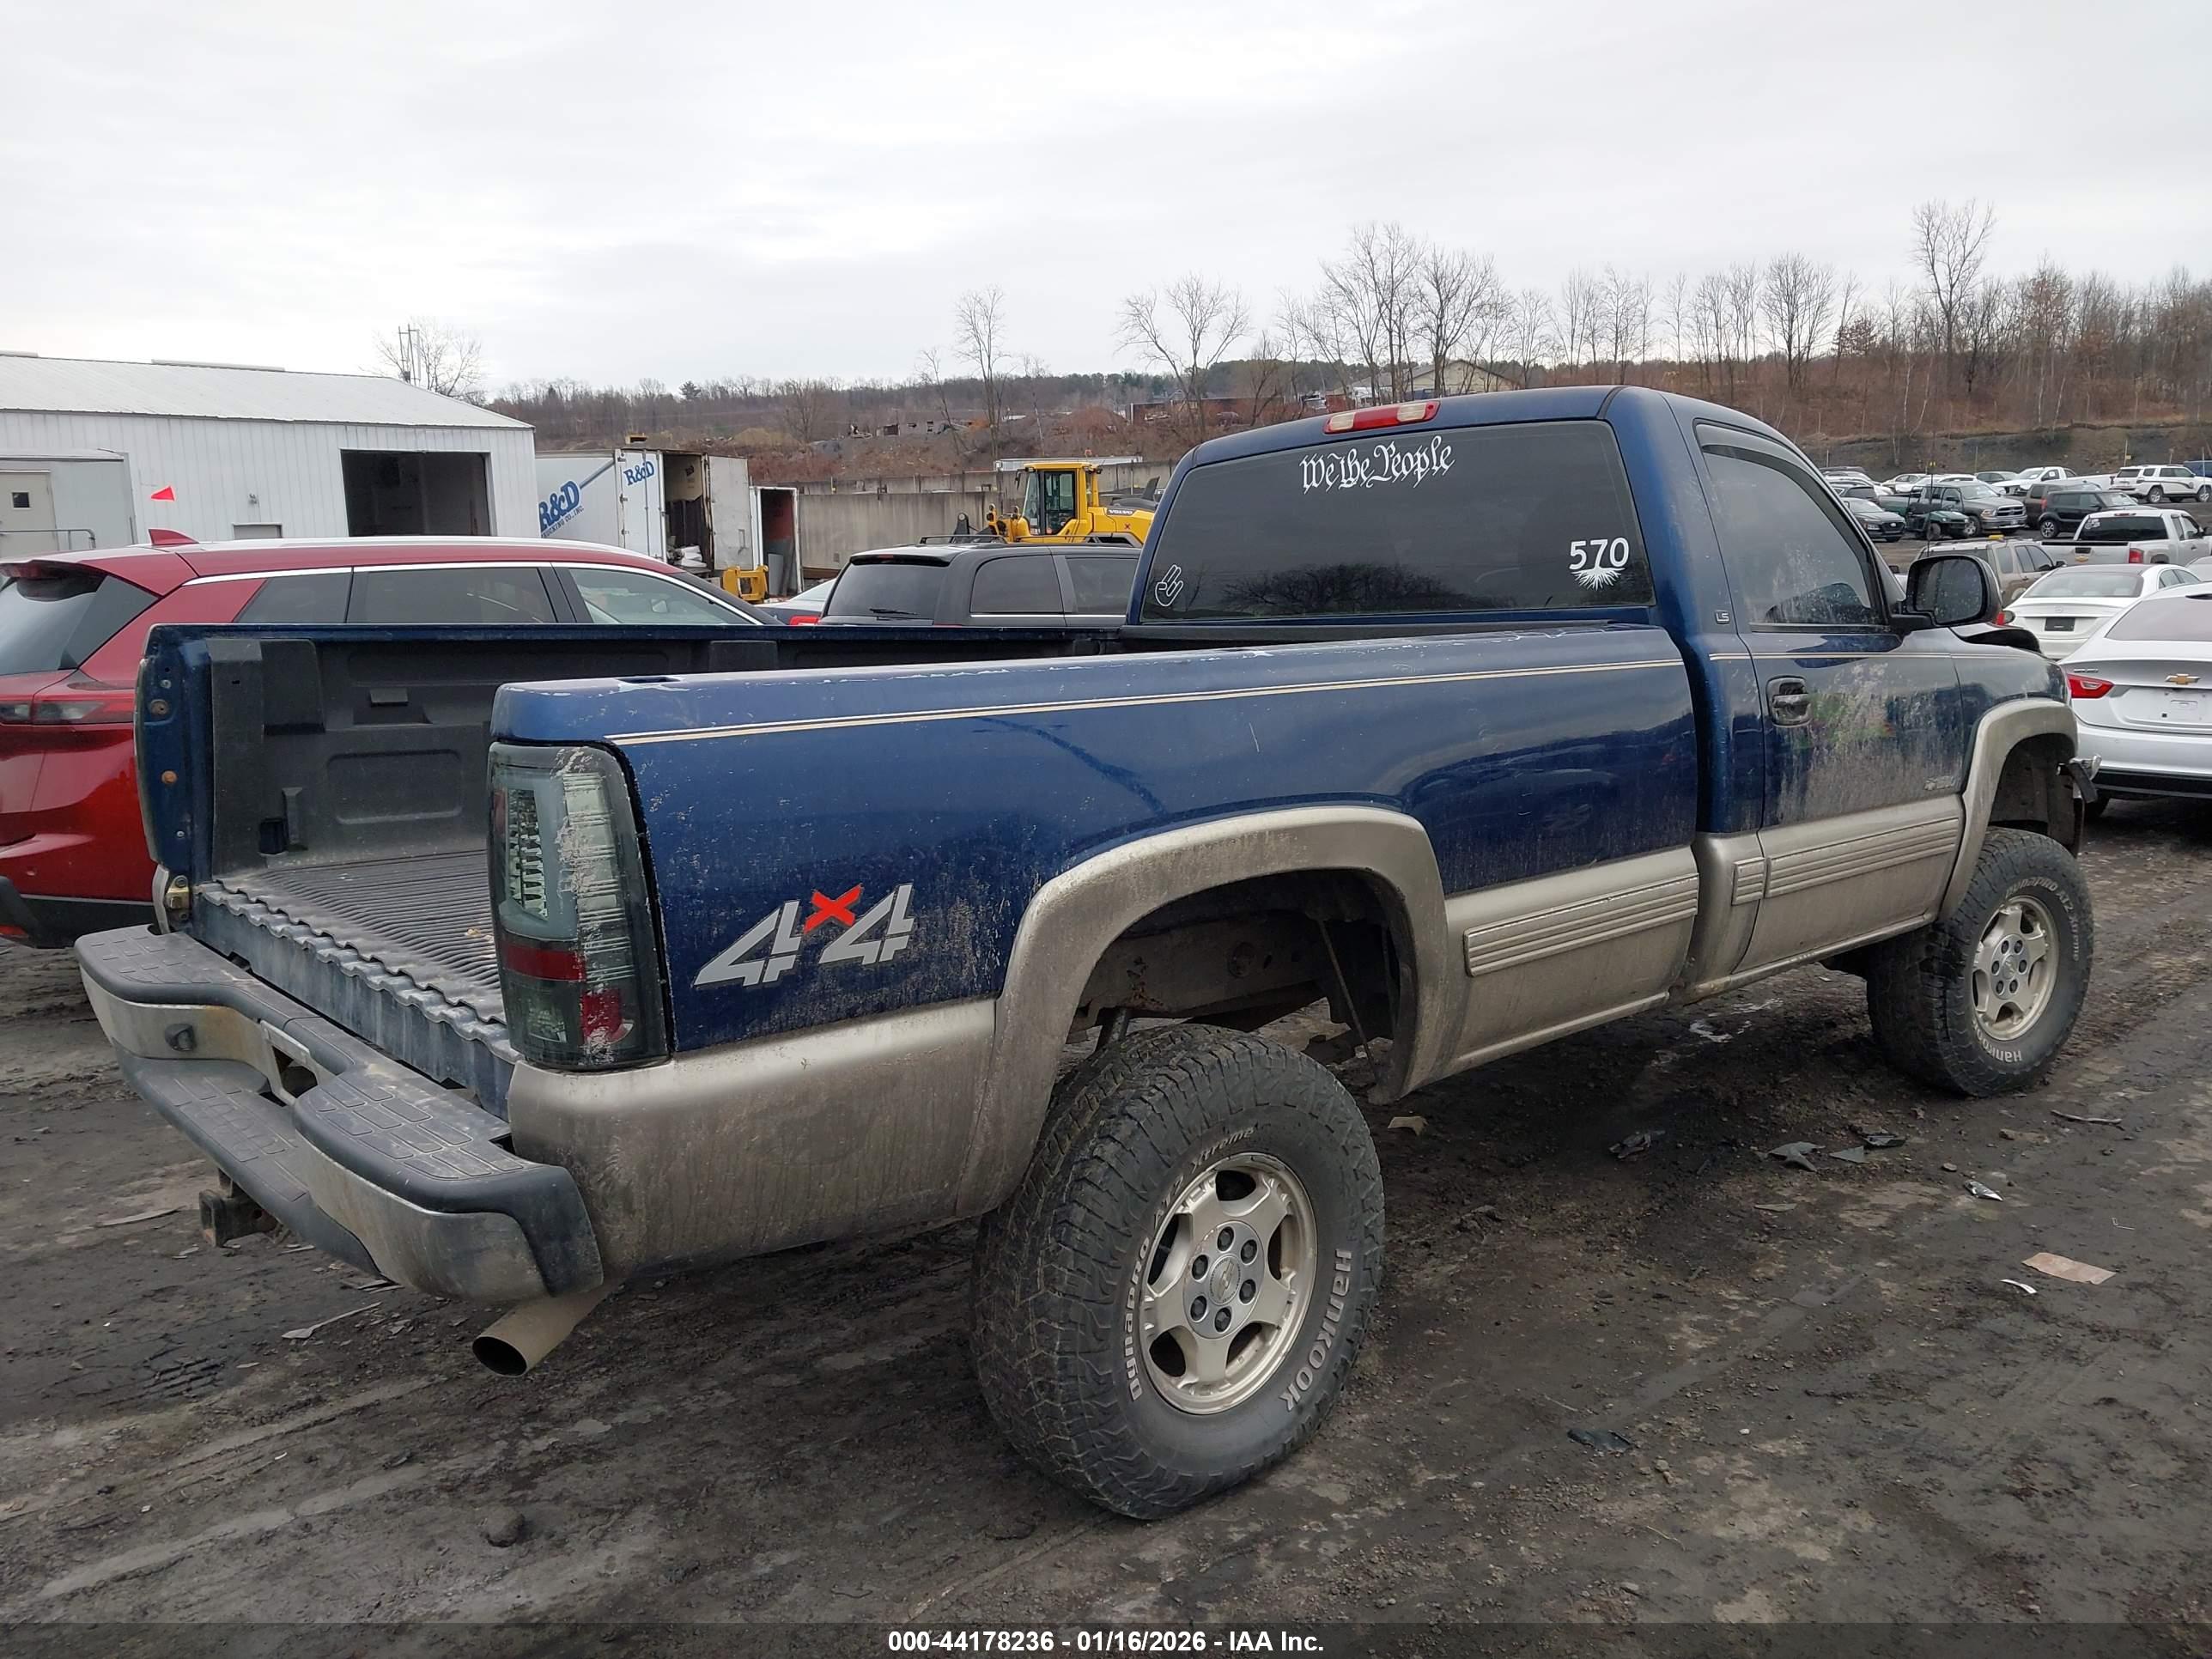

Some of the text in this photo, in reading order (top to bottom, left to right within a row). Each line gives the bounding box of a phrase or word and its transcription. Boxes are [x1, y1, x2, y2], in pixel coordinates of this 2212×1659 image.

[623, 461, 653, 486] R&D
[1299, 453, 1340, 495] We
[1366, 435, 1455, 488] People
[538, 480, 580, 532] R&D
[1569, 537, 1630, 571] 570
[1716, 612, 1729, 622] LS
